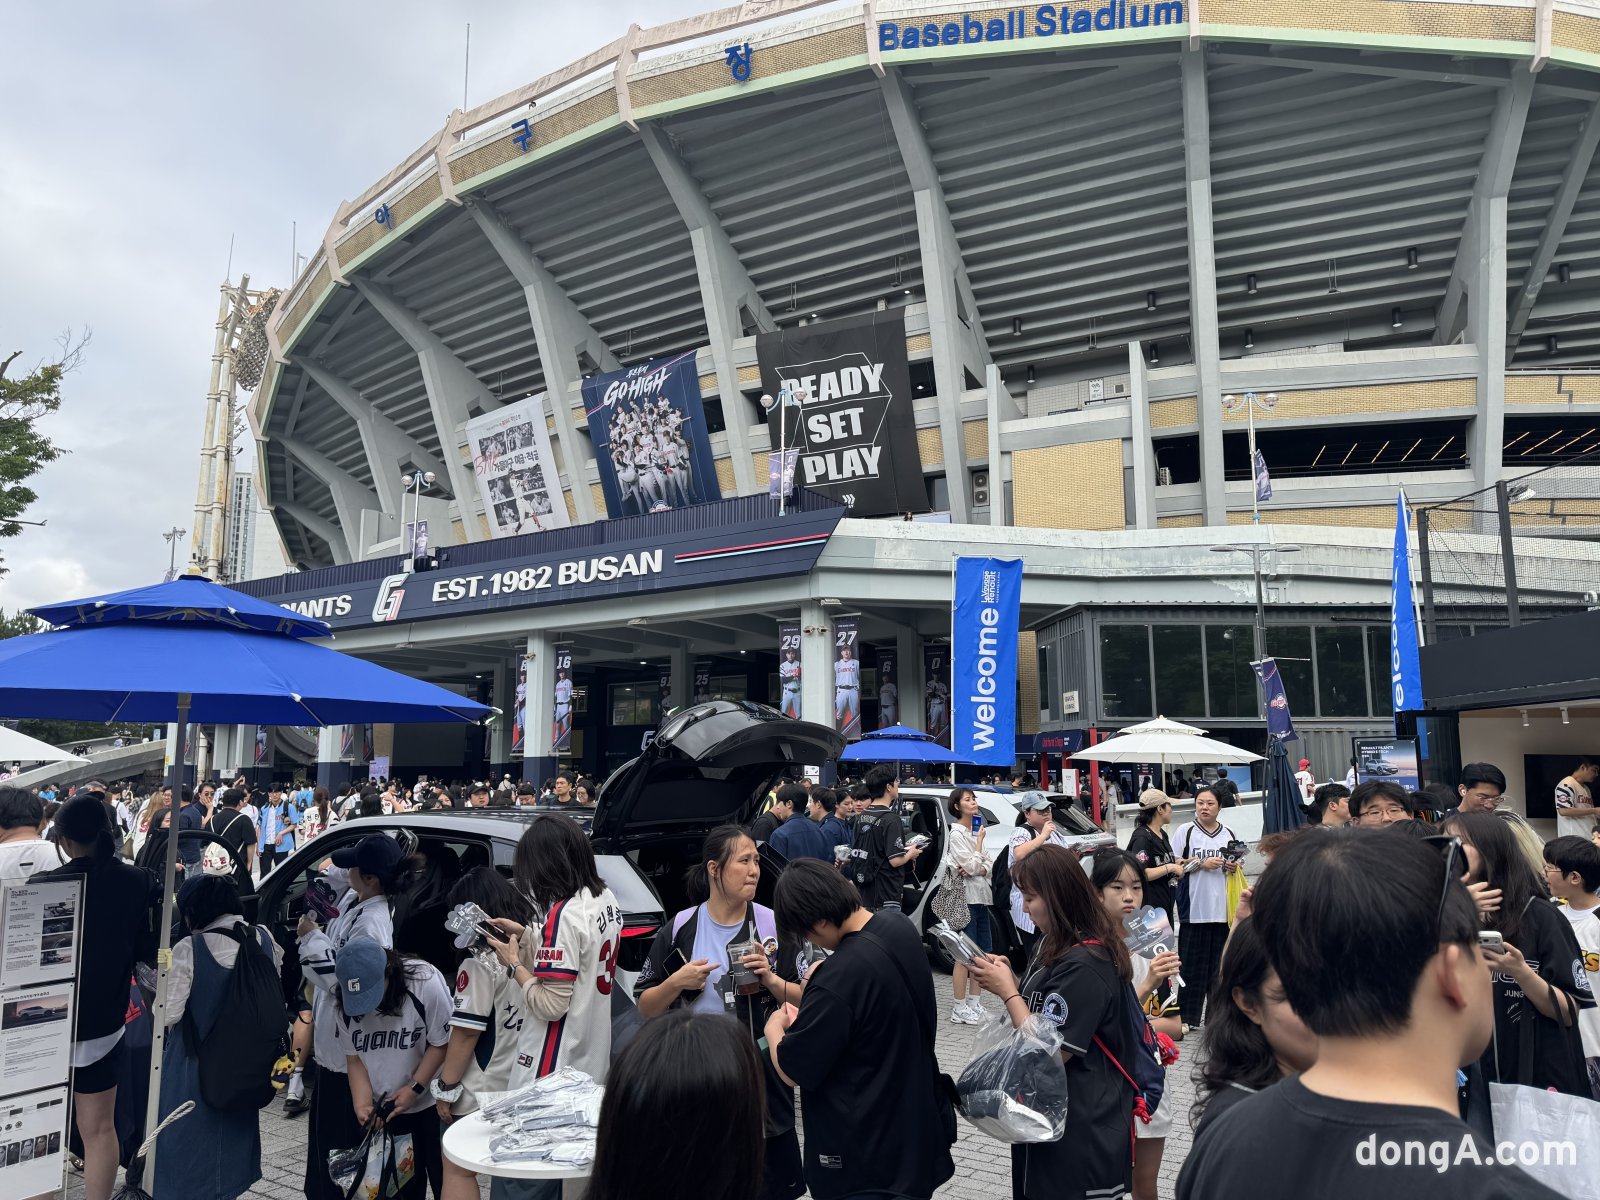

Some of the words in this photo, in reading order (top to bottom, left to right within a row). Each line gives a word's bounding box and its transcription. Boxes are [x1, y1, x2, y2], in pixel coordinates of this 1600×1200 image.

[879, 10, 1025, 50] Baseball
[1034, 0, 1184, 37] Stadium
[375, 203, 393, 230] 야
[510, 118, 532, 152] 구
[725, 43, 754, 82] 장
[808, 407, 864, 444] SET
[802, 446, 882, 484] PLAY
[431, 565, 552, 602] EST.1982
[558, 549, 663, 585] BUSAN
[781, 634, 801, 650] 29
[836, 630, 858, 647] 27
[557, 655, 572, 669] 16
